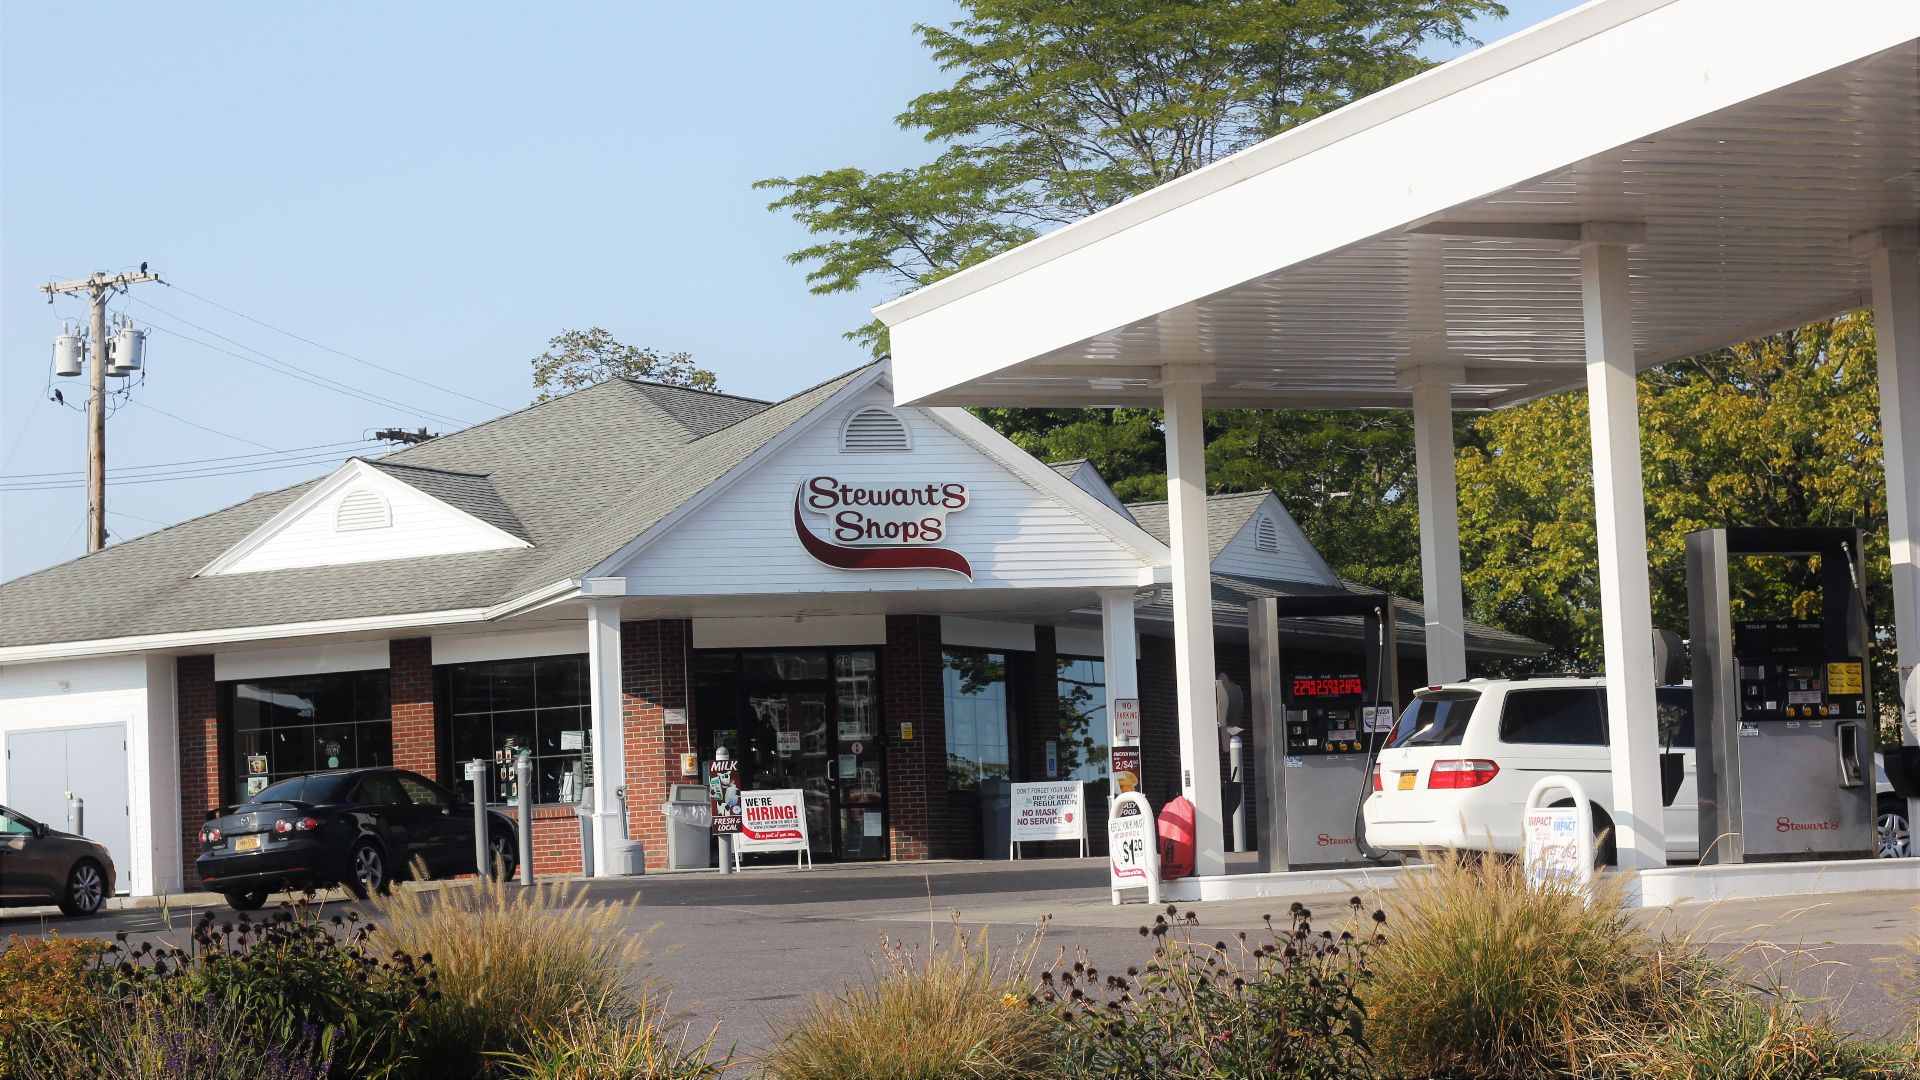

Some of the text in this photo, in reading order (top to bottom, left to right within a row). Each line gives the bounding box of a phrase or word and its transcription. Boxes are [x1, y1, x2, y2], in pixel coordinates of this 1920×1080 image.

[834, 510, 943, 543] Shops
[1857, 701, 1865, 714] 4
[710, 760, 738, 772] MILK
[745, 797, 772, 806] WE'RE
[746, 805, 798, 821] HIRING!
[714, 817, 735, 825] FRESH
[1030, 816, 1062, 825] SERVICE
[1528, 816, 1552, 826] IMPACT
[1554, 821, 1576, 832] IMPACT
